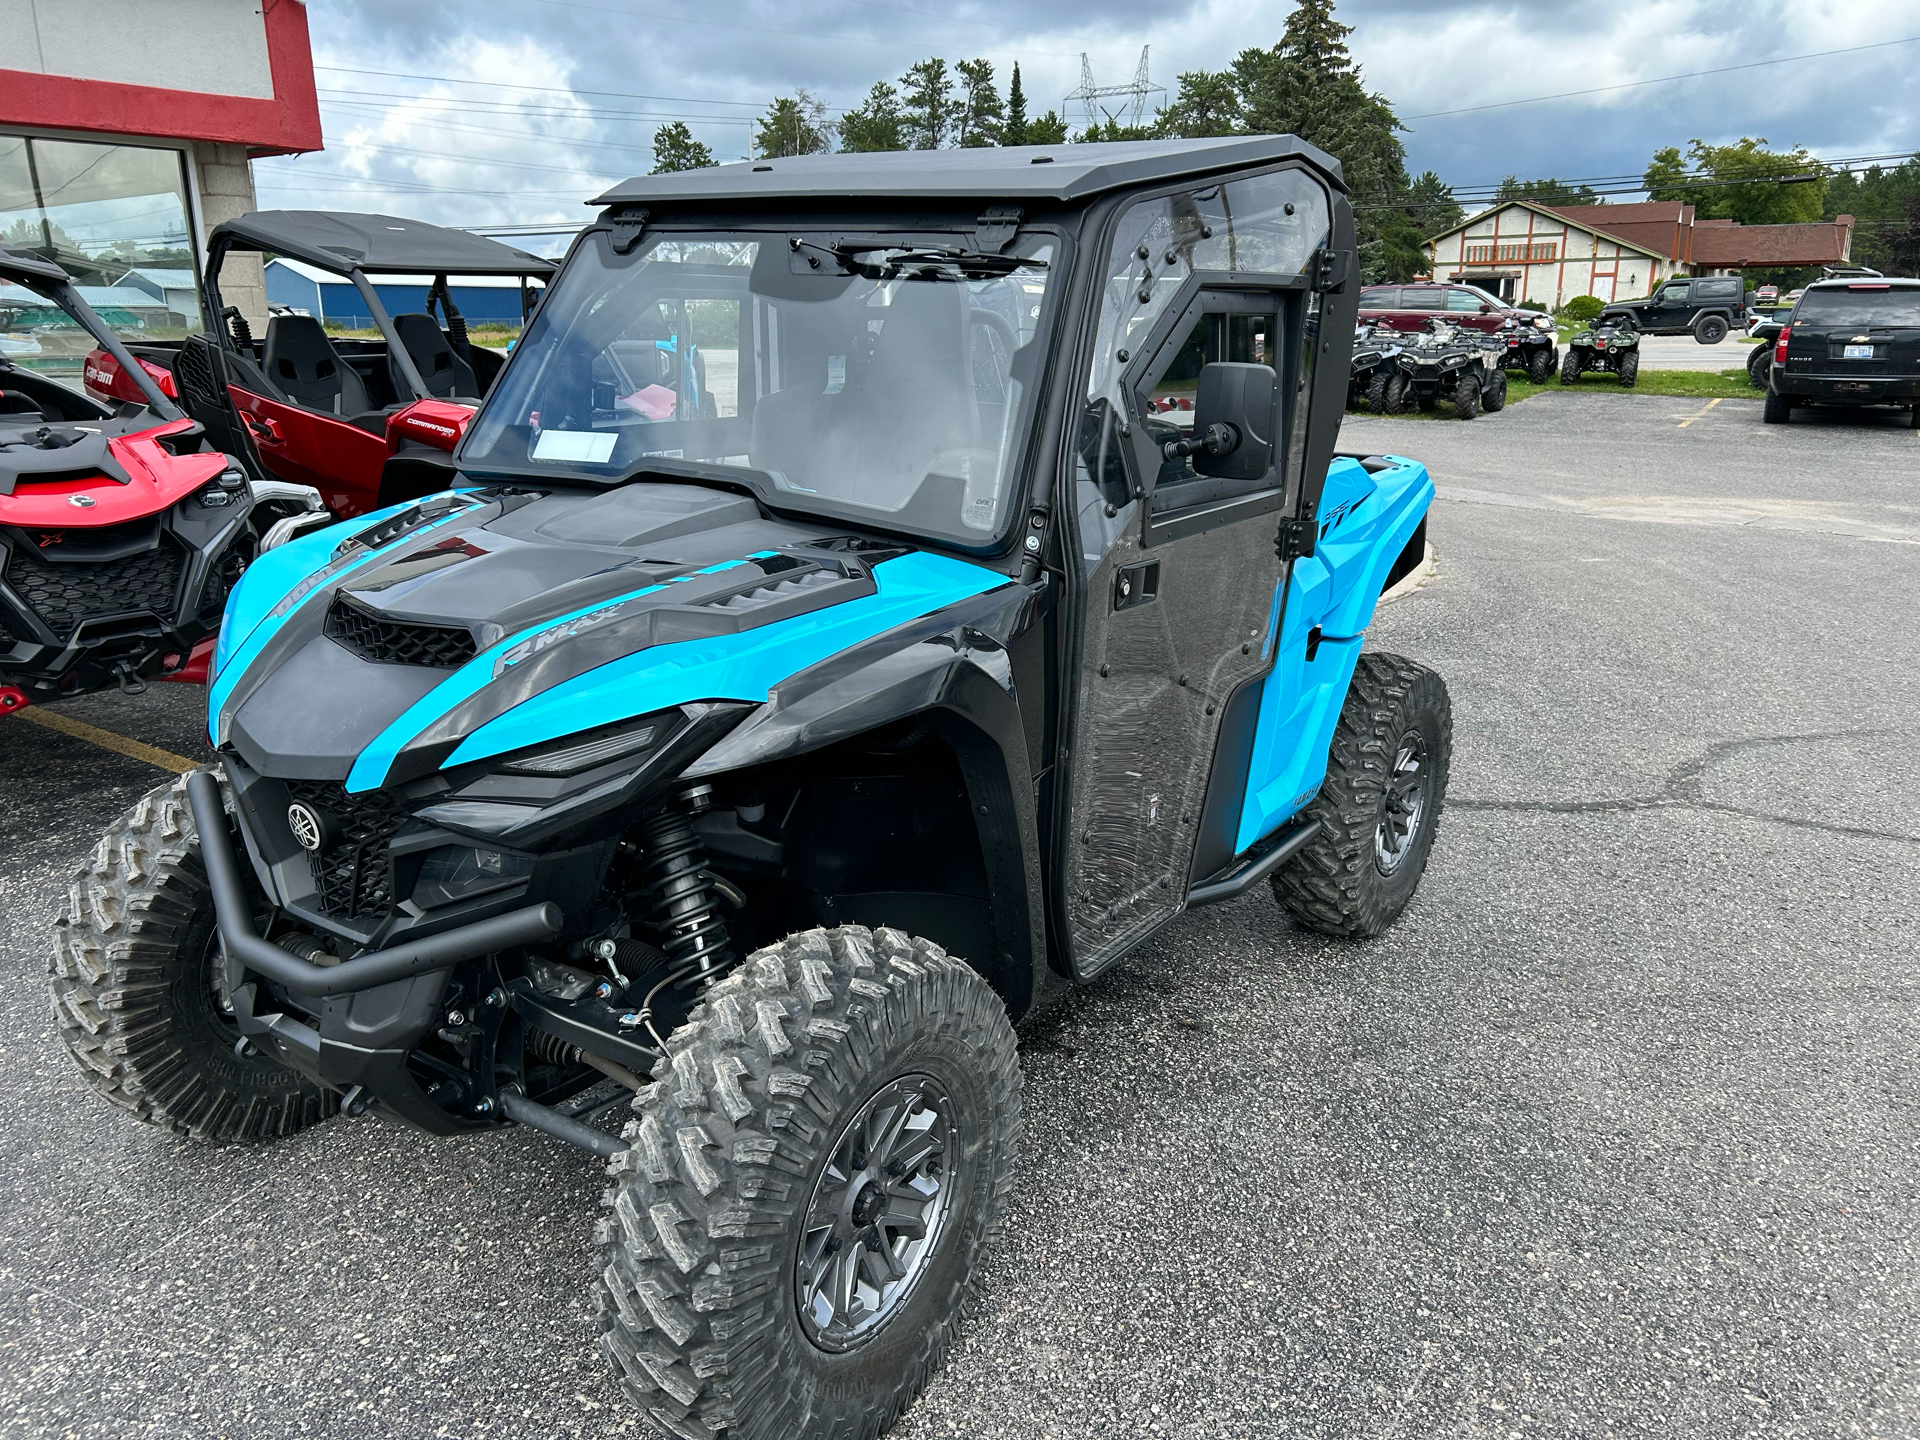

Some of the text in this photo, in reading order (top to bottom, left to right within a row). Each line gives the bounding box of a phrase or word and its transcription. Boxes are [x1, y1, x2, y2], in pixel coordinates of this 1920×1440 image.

[86, 365, 114, 386] can-am
[406, 417, 456, 435] COMMANDER
[1292, 782, 1321, 810] YAMAHA
